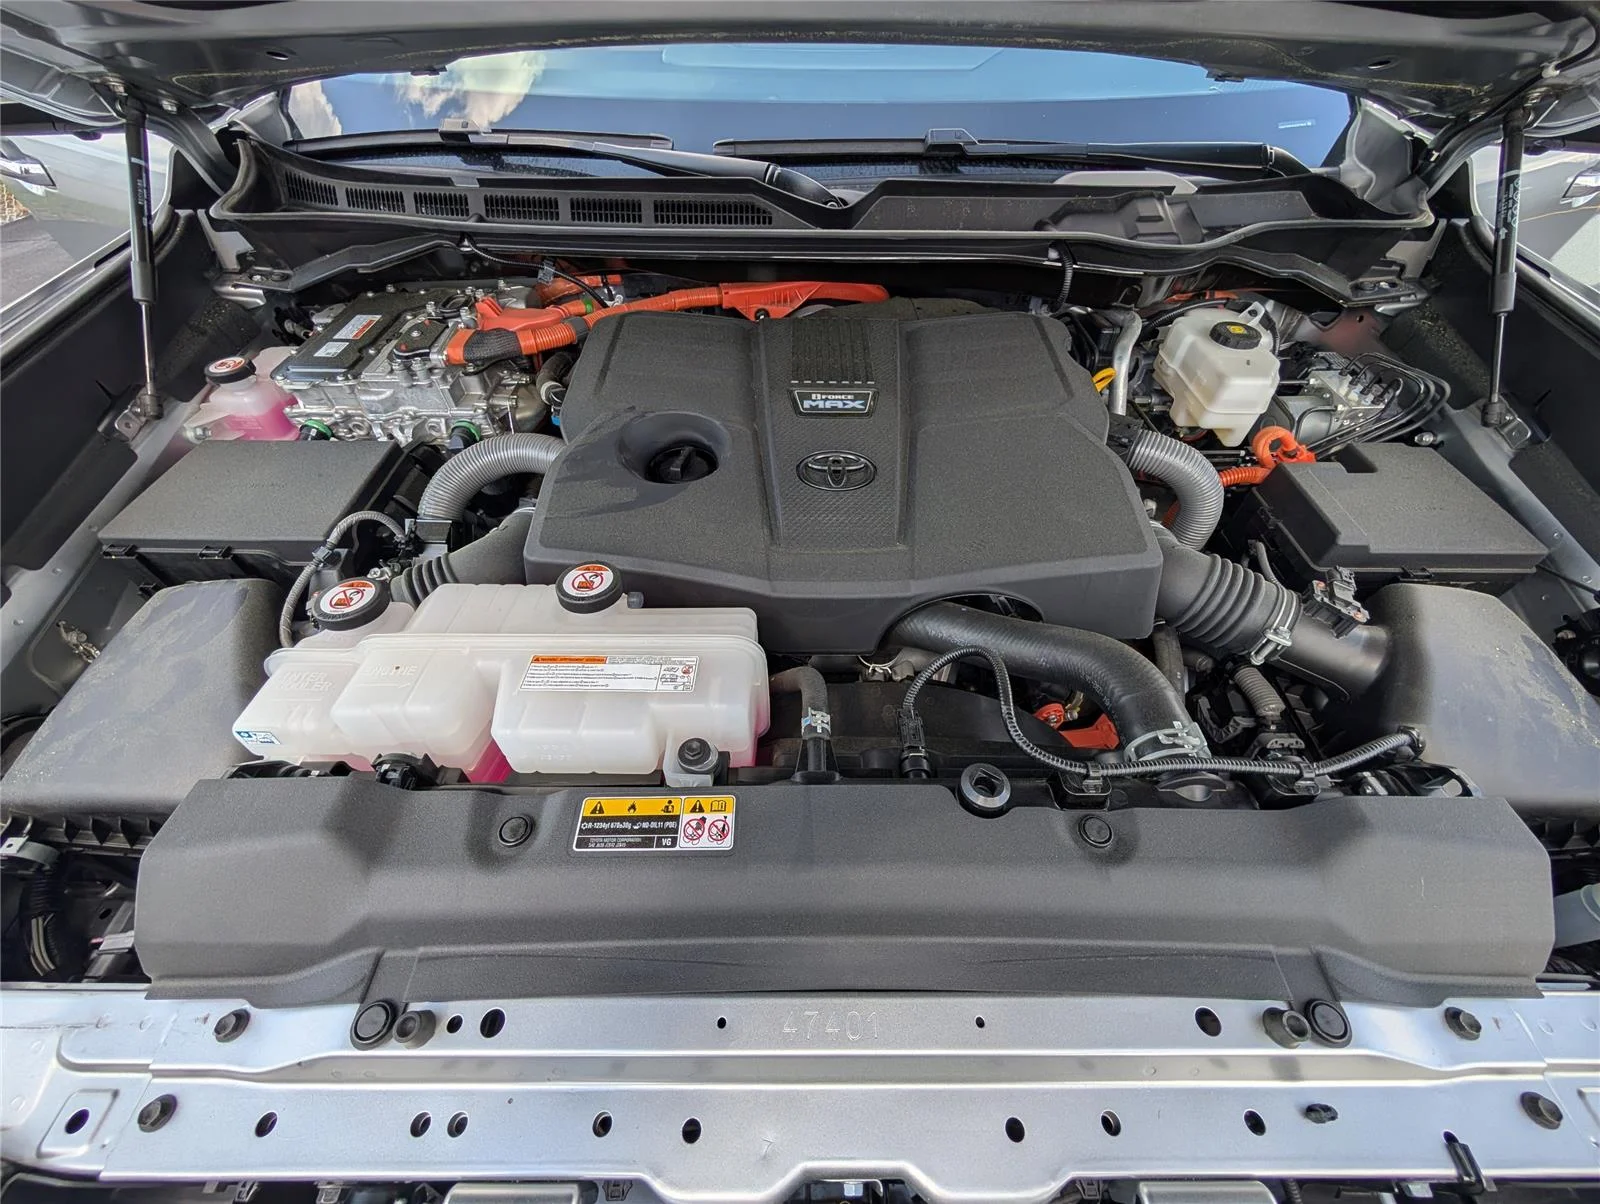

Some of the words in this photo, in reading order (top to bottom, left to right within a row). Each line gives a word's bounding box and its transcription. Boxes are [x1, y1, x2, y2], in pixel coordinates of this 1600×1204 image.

[803, 400, 865, 409] MAX
[662, 838, 672, 846] VG
[782, 1010, 879, 1041] 47401
